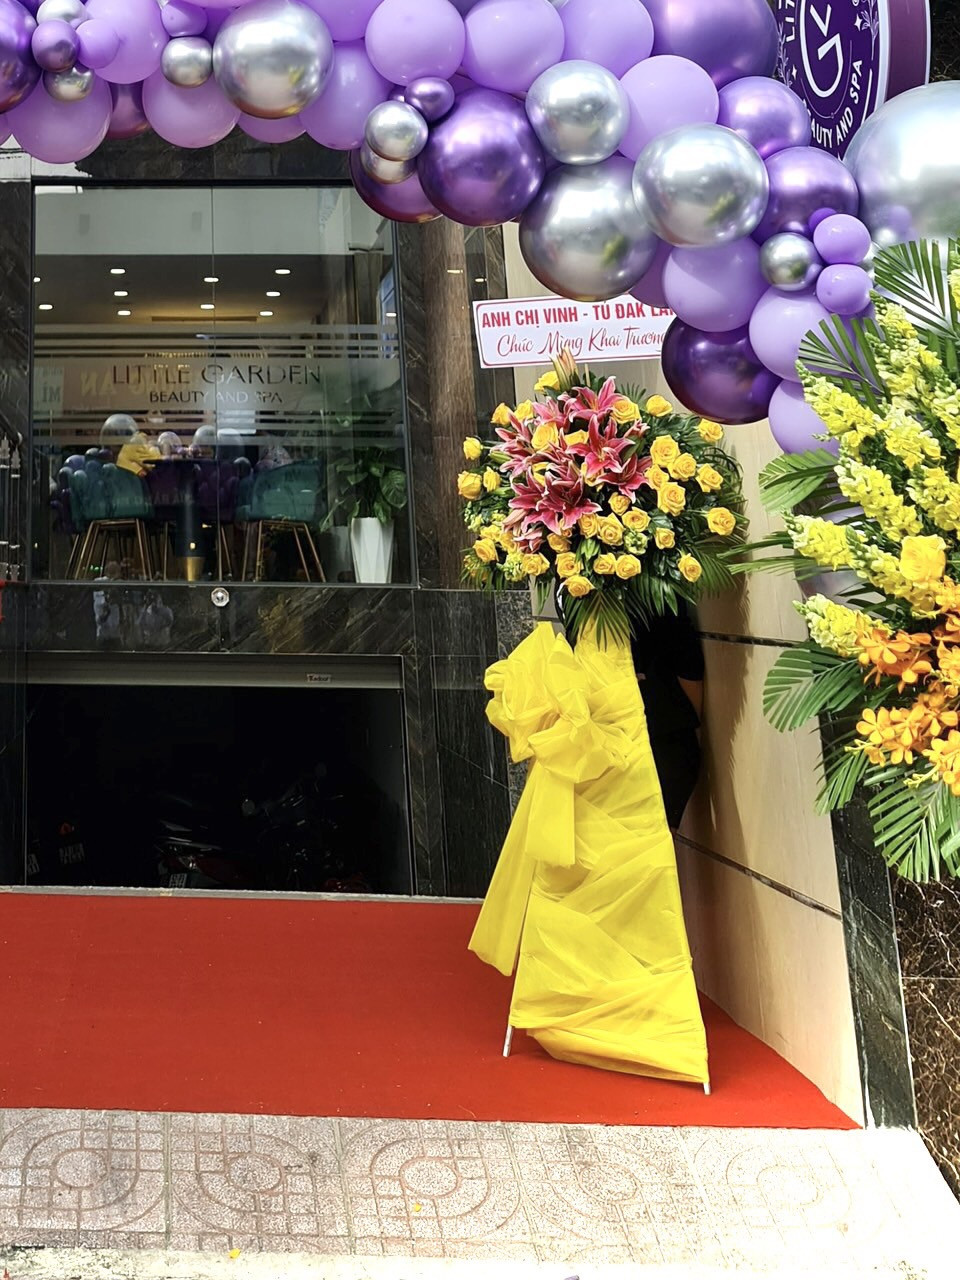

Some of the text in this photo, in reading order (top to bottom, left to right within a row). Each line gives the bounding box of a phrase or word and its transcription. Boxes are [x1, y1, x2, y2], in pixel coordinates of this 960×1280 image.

[836, 108, 854, 146] AND
[850, 59, 863, 105] SPA
[482, 311, 511, 328] ANH
[516, 309, 540, 328] CHỊ
[543, 306, 579, 324] VINH
[497, 330, 534, 357] Chúc
[588, 326, 621, 352] Khai
[113, 364, 191, 384] LITTLE
[201, 364, 321, 385] GARDEN
[150, 390, 209, 404] BEAUTY
[215, 390, 249, 404] AND
